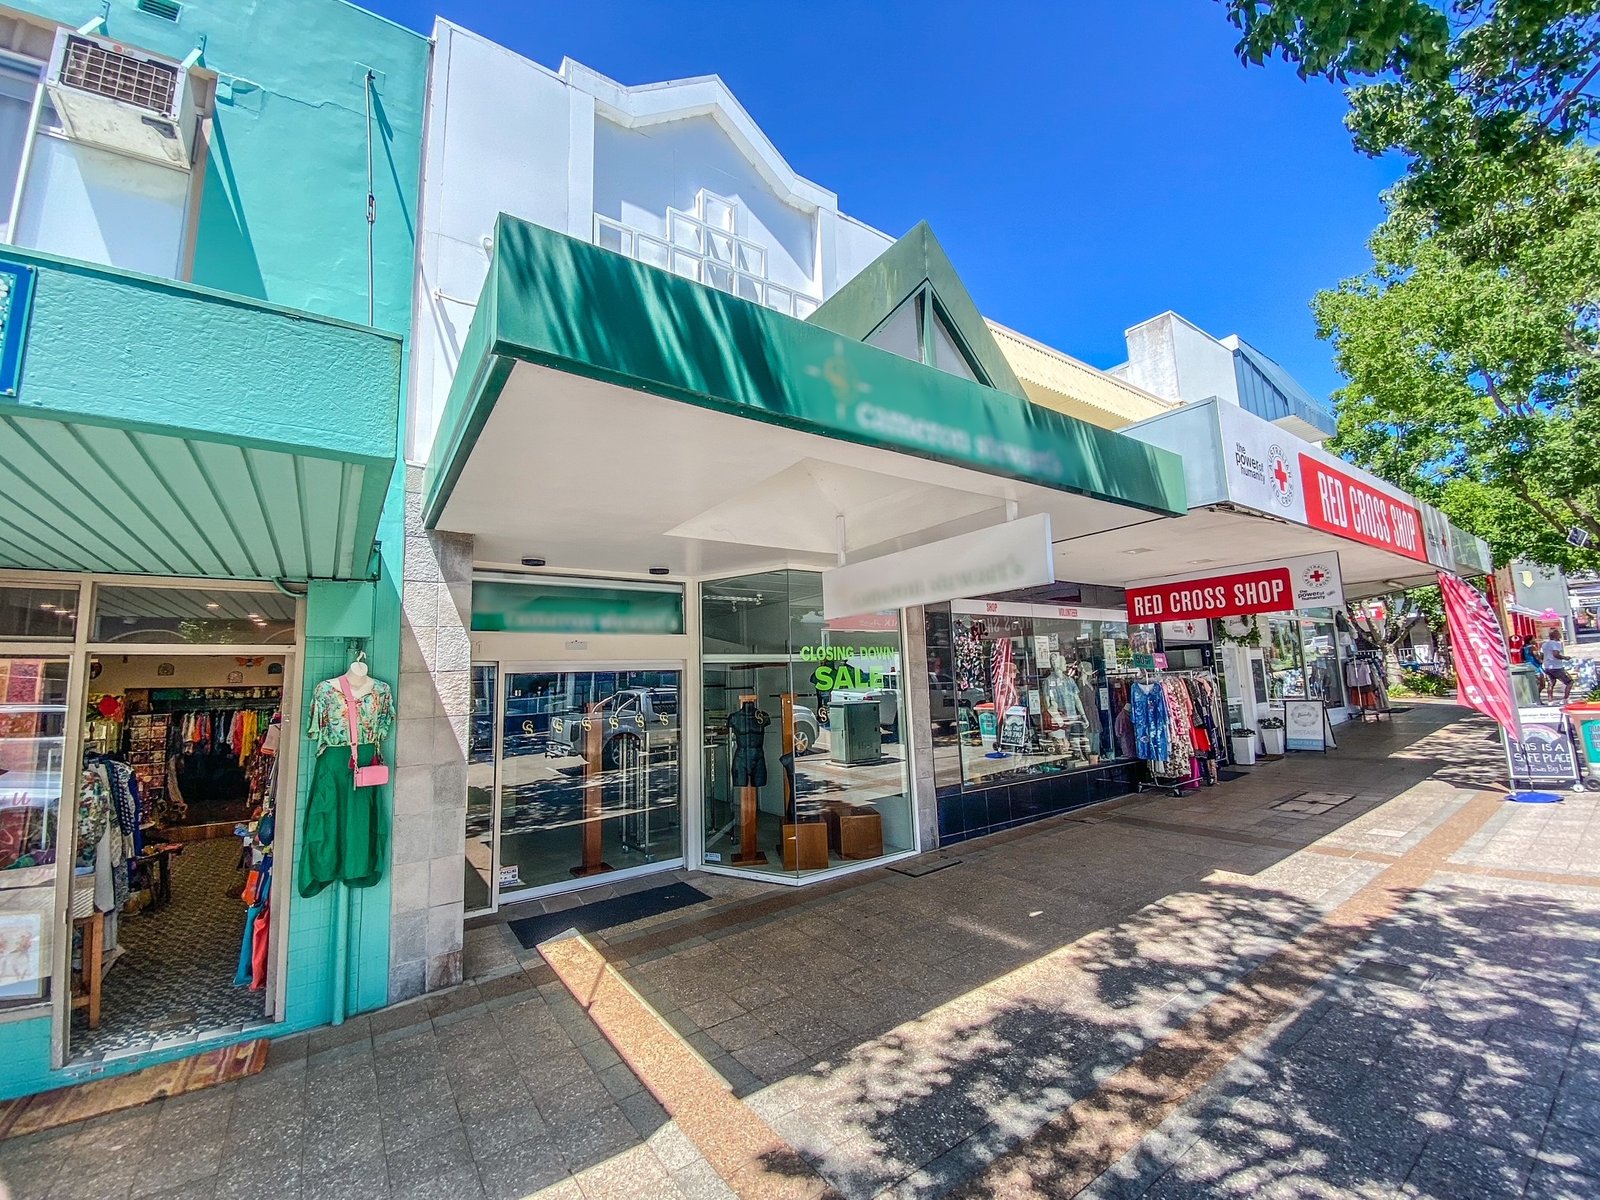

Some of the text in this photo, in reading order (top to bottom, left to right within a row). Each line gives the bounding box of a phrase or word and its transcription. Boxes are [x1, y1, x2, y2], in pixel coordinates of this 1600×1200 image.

[1235, 442, 1246, 454] the
[1235, 452, 1259, 471] power
[1240, 464, 1266, 485] humanity
[1317, 470, 1416, 552] RED CROSS SHOP
[1133, 579, 1284, 617] RED CROSS SHOP
[986, 602, 998, 613] SHOP
[801, 645, 895, 661] CLOSING DOWN
[815, 665, 885, 691] SALE
[1541, 743, 1553, 752] IS
[1554, 743, 1565, 752] A
[1542, 754, 1572, 763] PLACE
[1547, 764, 1559, 774] Big
